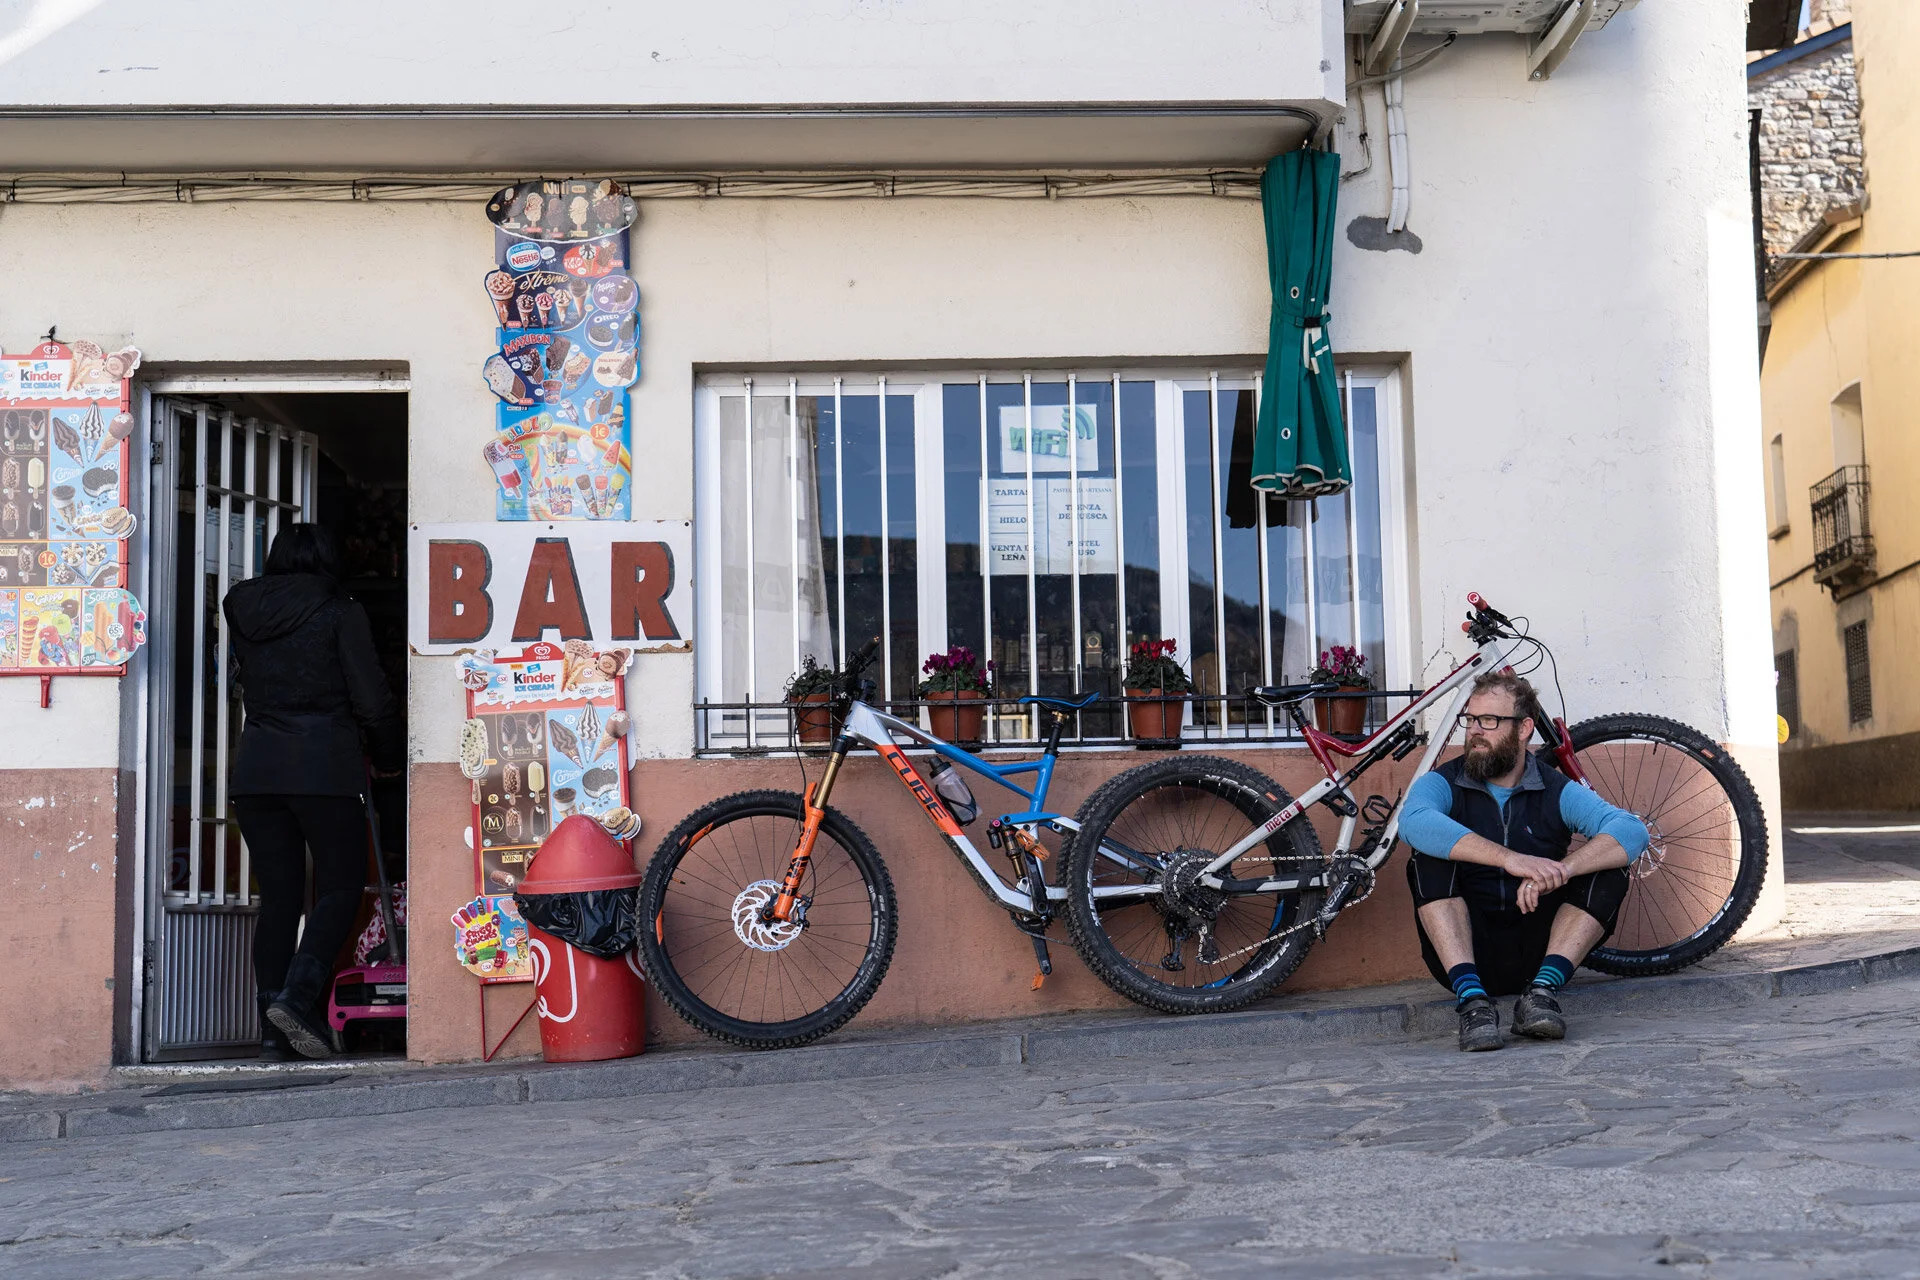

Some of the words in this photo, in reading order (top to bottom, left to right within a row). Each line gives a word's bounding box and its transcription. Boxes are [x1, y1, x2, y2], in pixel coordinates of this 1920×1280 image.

[512, 252, 539, 265] Nestlé
[504, 334, 550, 356] MAXIBON
[20, 370, 62, 381] kinder
[428, 536, 682, 644] BAR
[514, 672, 556, 684] kinder
[602, 760, 616, 770] GO!
[887, 751, 947, 820] CUBE
[1264, 809, 1292, 832] meta
